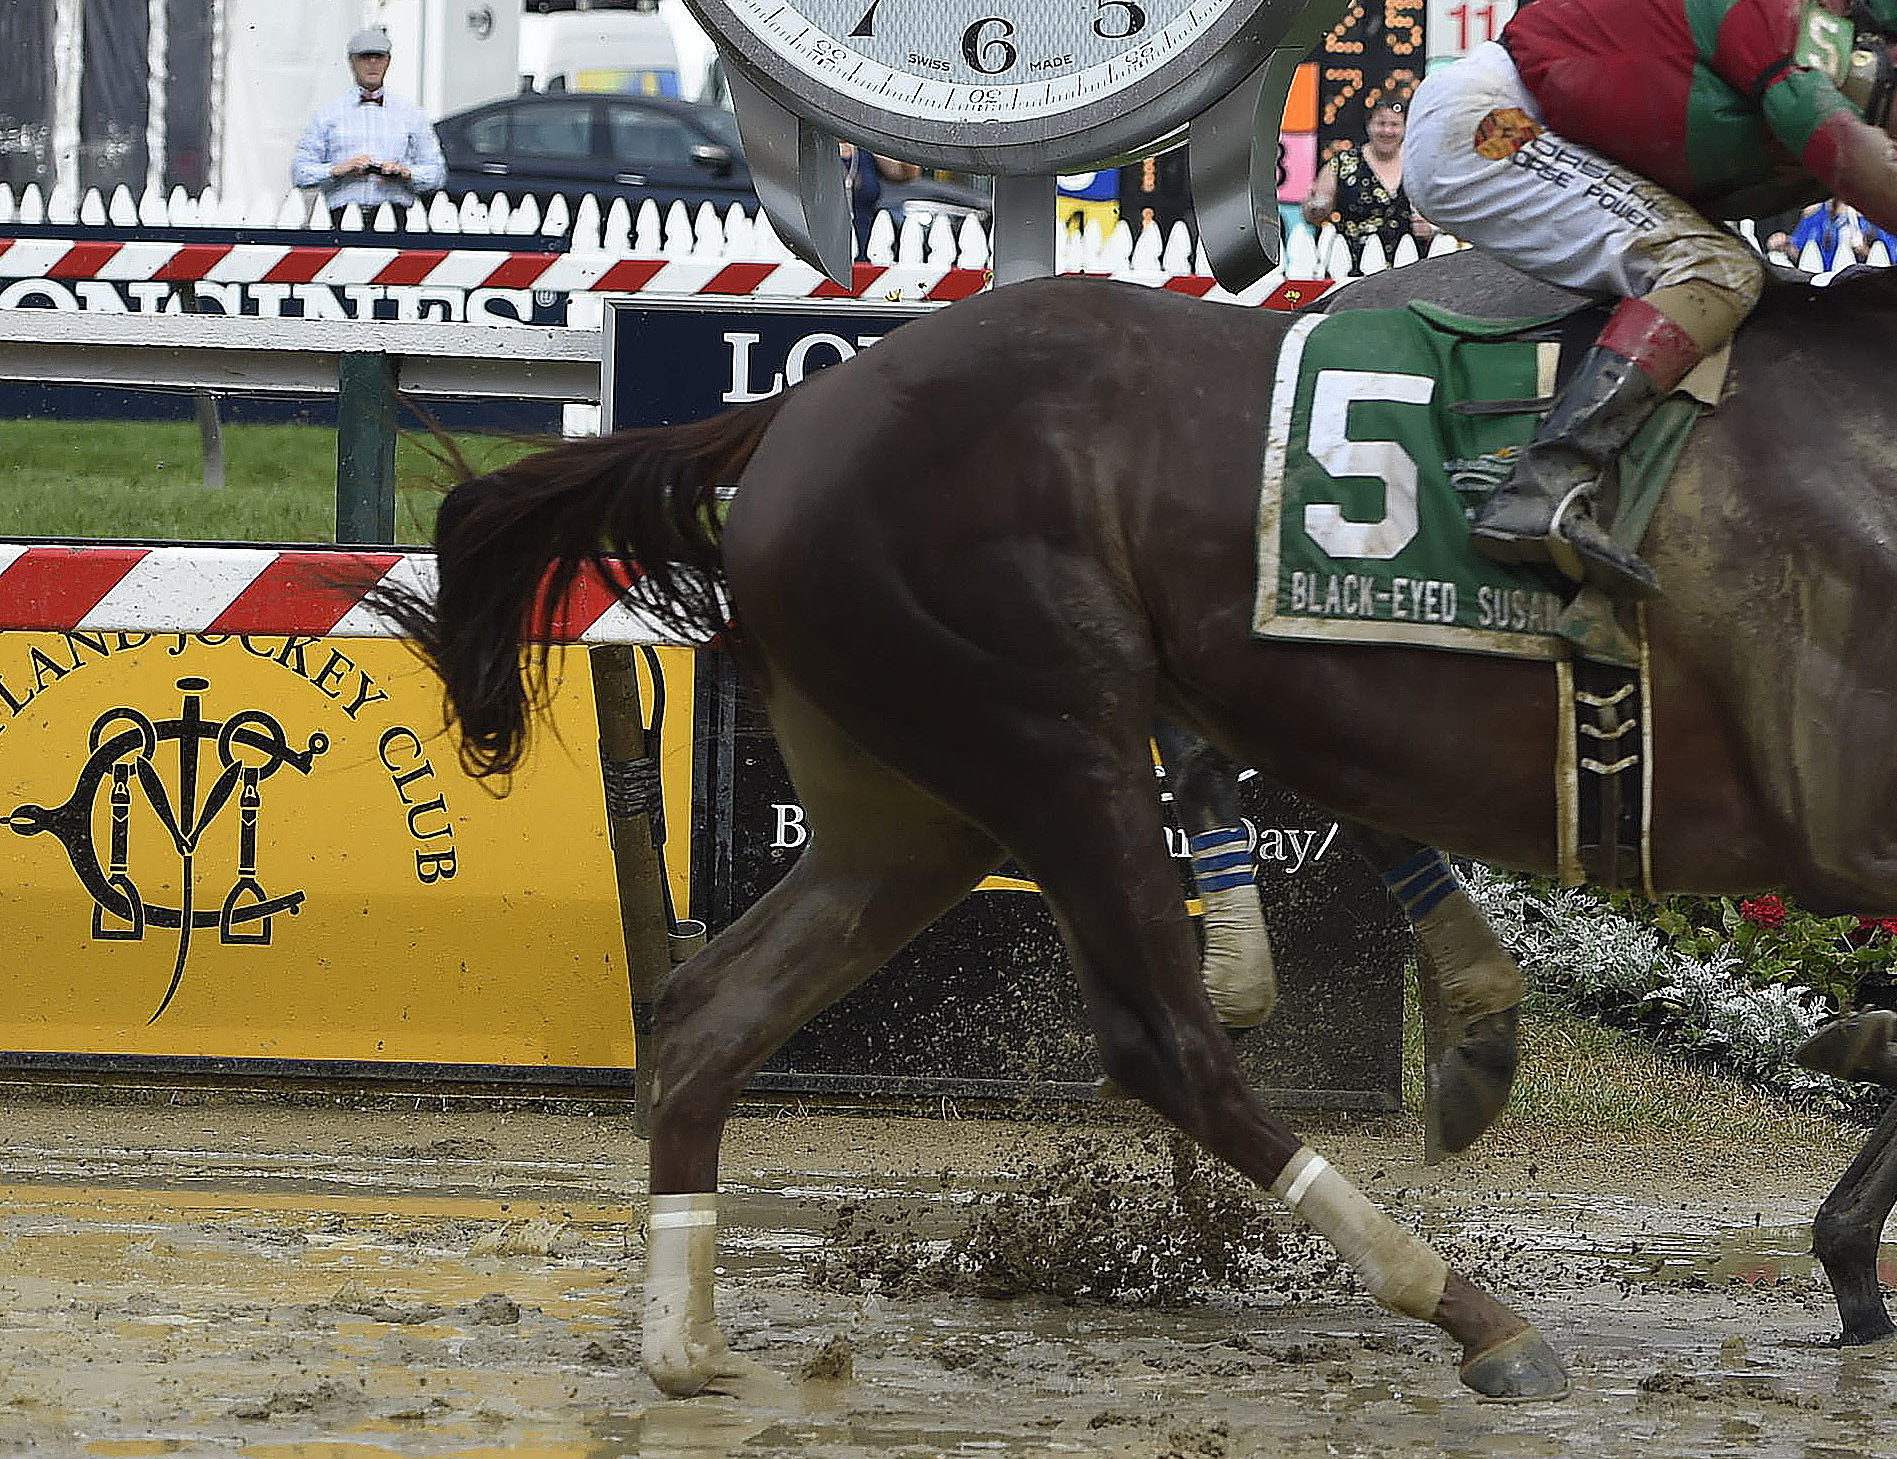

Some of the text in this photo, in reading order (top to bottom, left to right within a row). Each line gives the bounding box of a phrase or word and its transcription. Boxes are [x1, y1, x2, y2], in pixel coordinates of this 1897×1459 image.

[907, 53, 1073, 73] SWISS MADE
[961, 16, 1018, 75] 6
[1512, 149, 1576, 190] ORSE
[1303, 368, 1436, 560] 5
[1290, 571, 1459, 624] BLACK-EYED
[377, 725, 460, 885] CLUB
